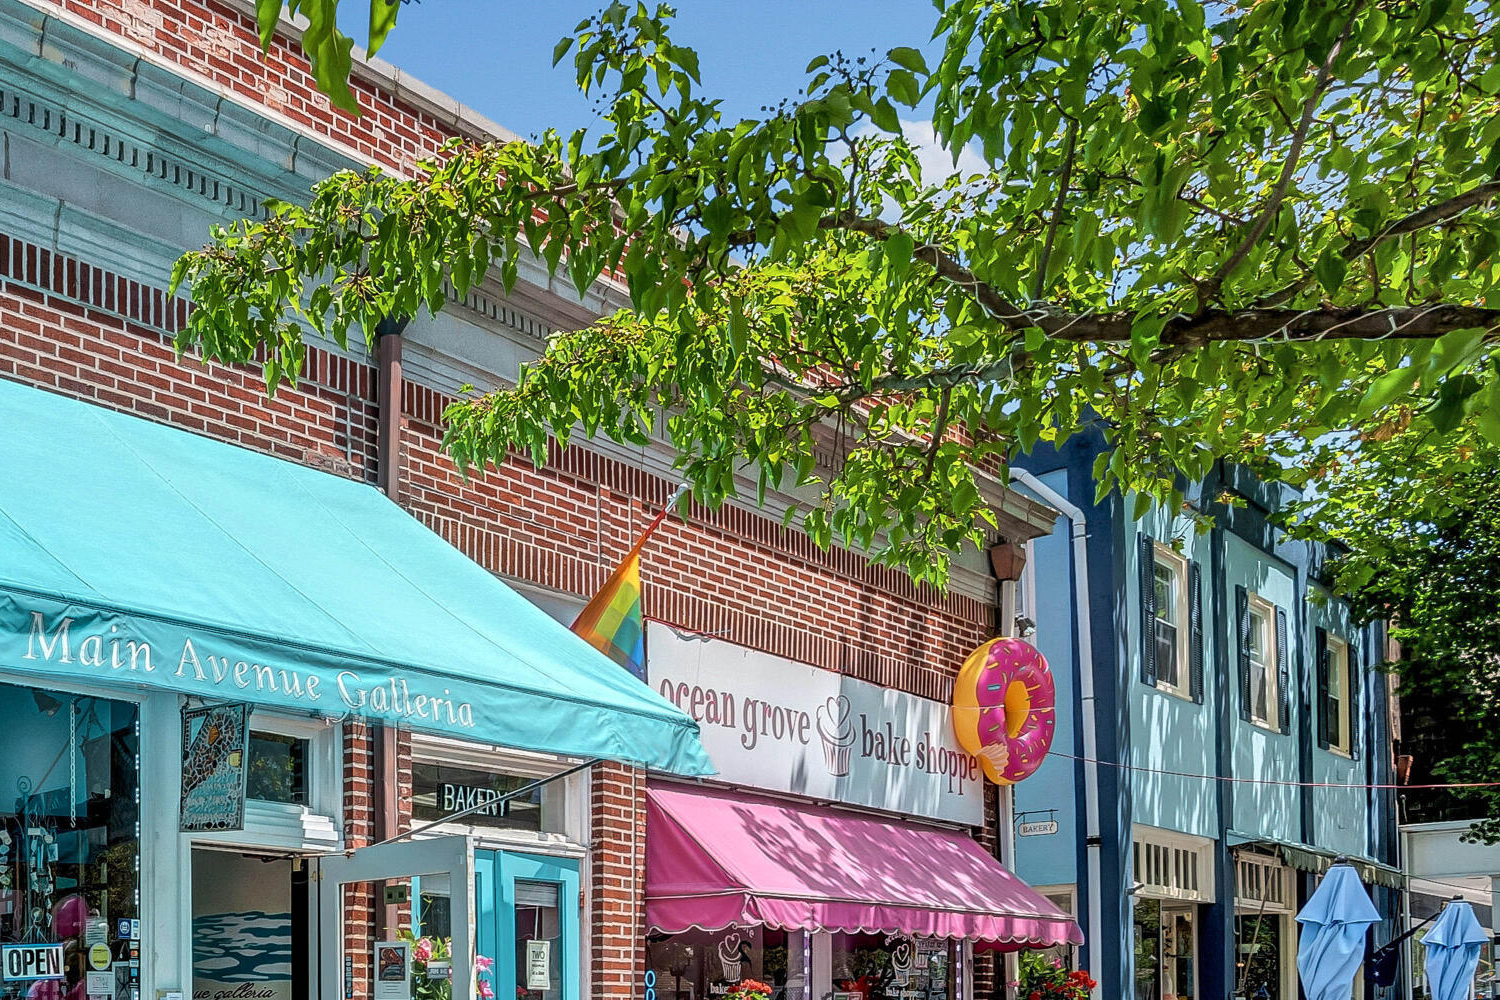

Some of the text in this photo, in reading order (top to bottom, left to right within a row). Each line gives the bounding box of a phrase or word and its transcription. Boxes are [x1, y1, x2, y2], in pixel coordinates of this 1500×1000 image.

[23, 611, 477, 728] Main Avenue Galleria
[740, 696, 811, 751] grove
[859, 713, 911, 767] bake
[916, 731, 978, 796] shoppe
[443, 783, 509, 817] BAKERY
[1022, 823, 1054, 834] BAKERY
[8, 948, 61, 977] OPEN
[531, 950, 546, 960] TWO
[709, 982, 729, 995] bake
